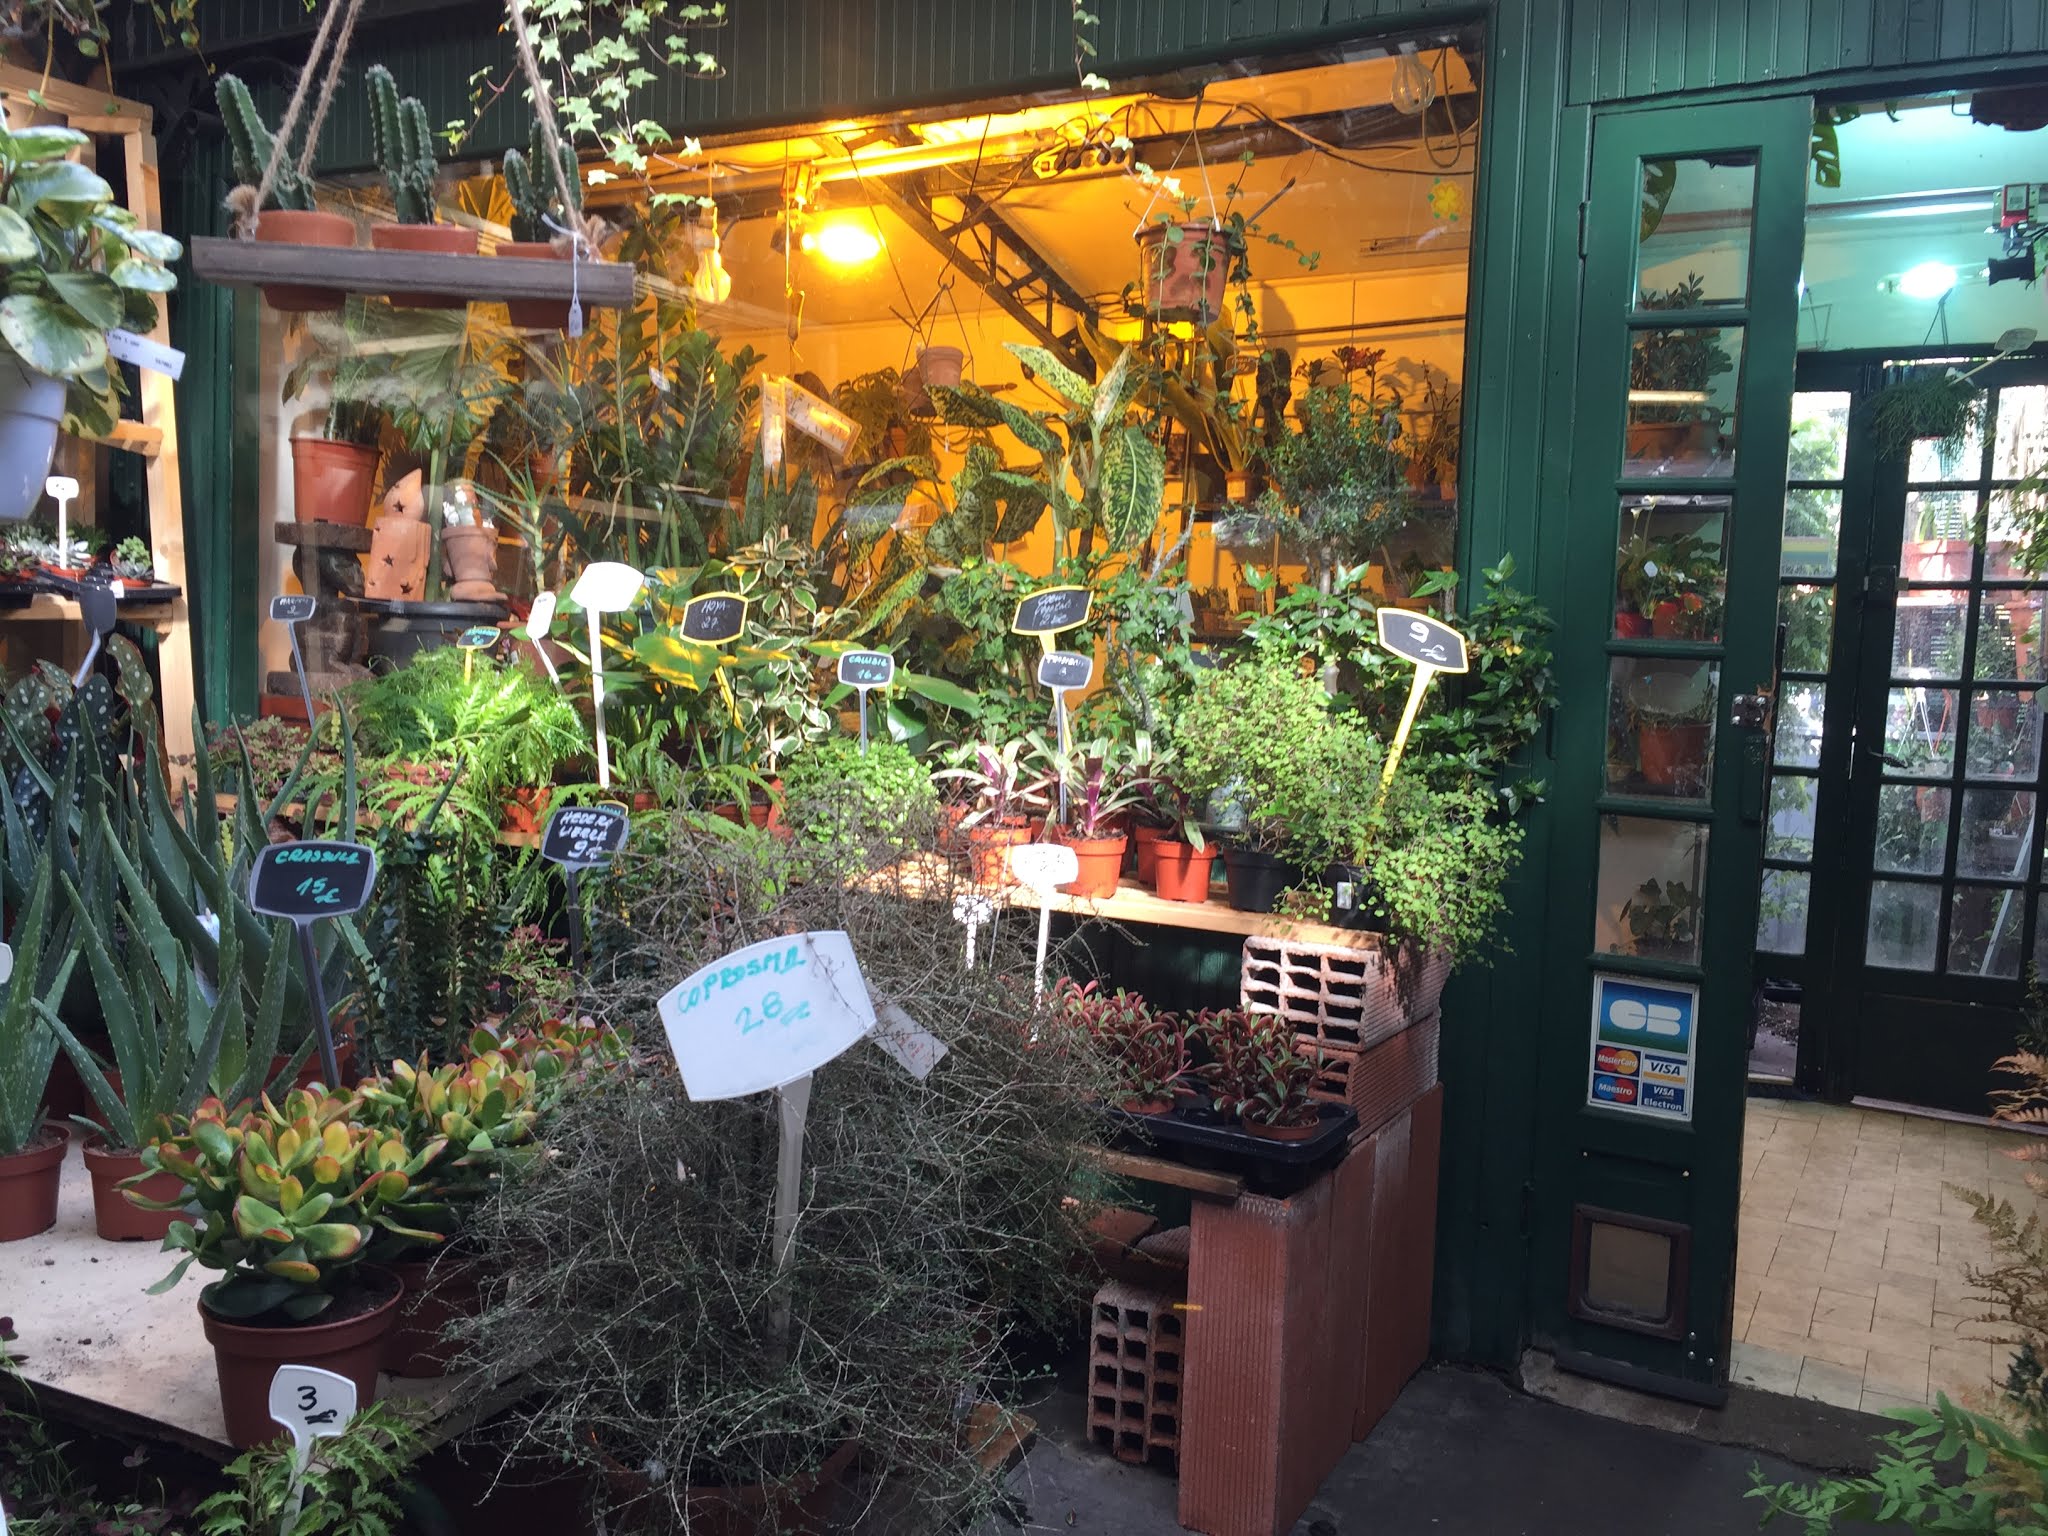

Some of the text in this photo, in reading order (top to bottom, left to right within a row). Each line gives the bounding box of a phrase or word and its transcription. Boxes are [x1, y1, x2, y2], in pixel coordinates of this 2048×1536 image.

[701, 600, 726, 614] HOYA
[676, 945, 806, 1014] COPROSMA
[1609, 999, 1682, 1036] CB
[1597, 1054, 1638, 1067] MasterCard
[1650, 1061, 1681, 1076] VISA
[1597, 1083, 1633, 1096] Maestro
[1653, 1085, 1675, 1097] VISA
[1643, 1097, 1682, 1111] Electron
